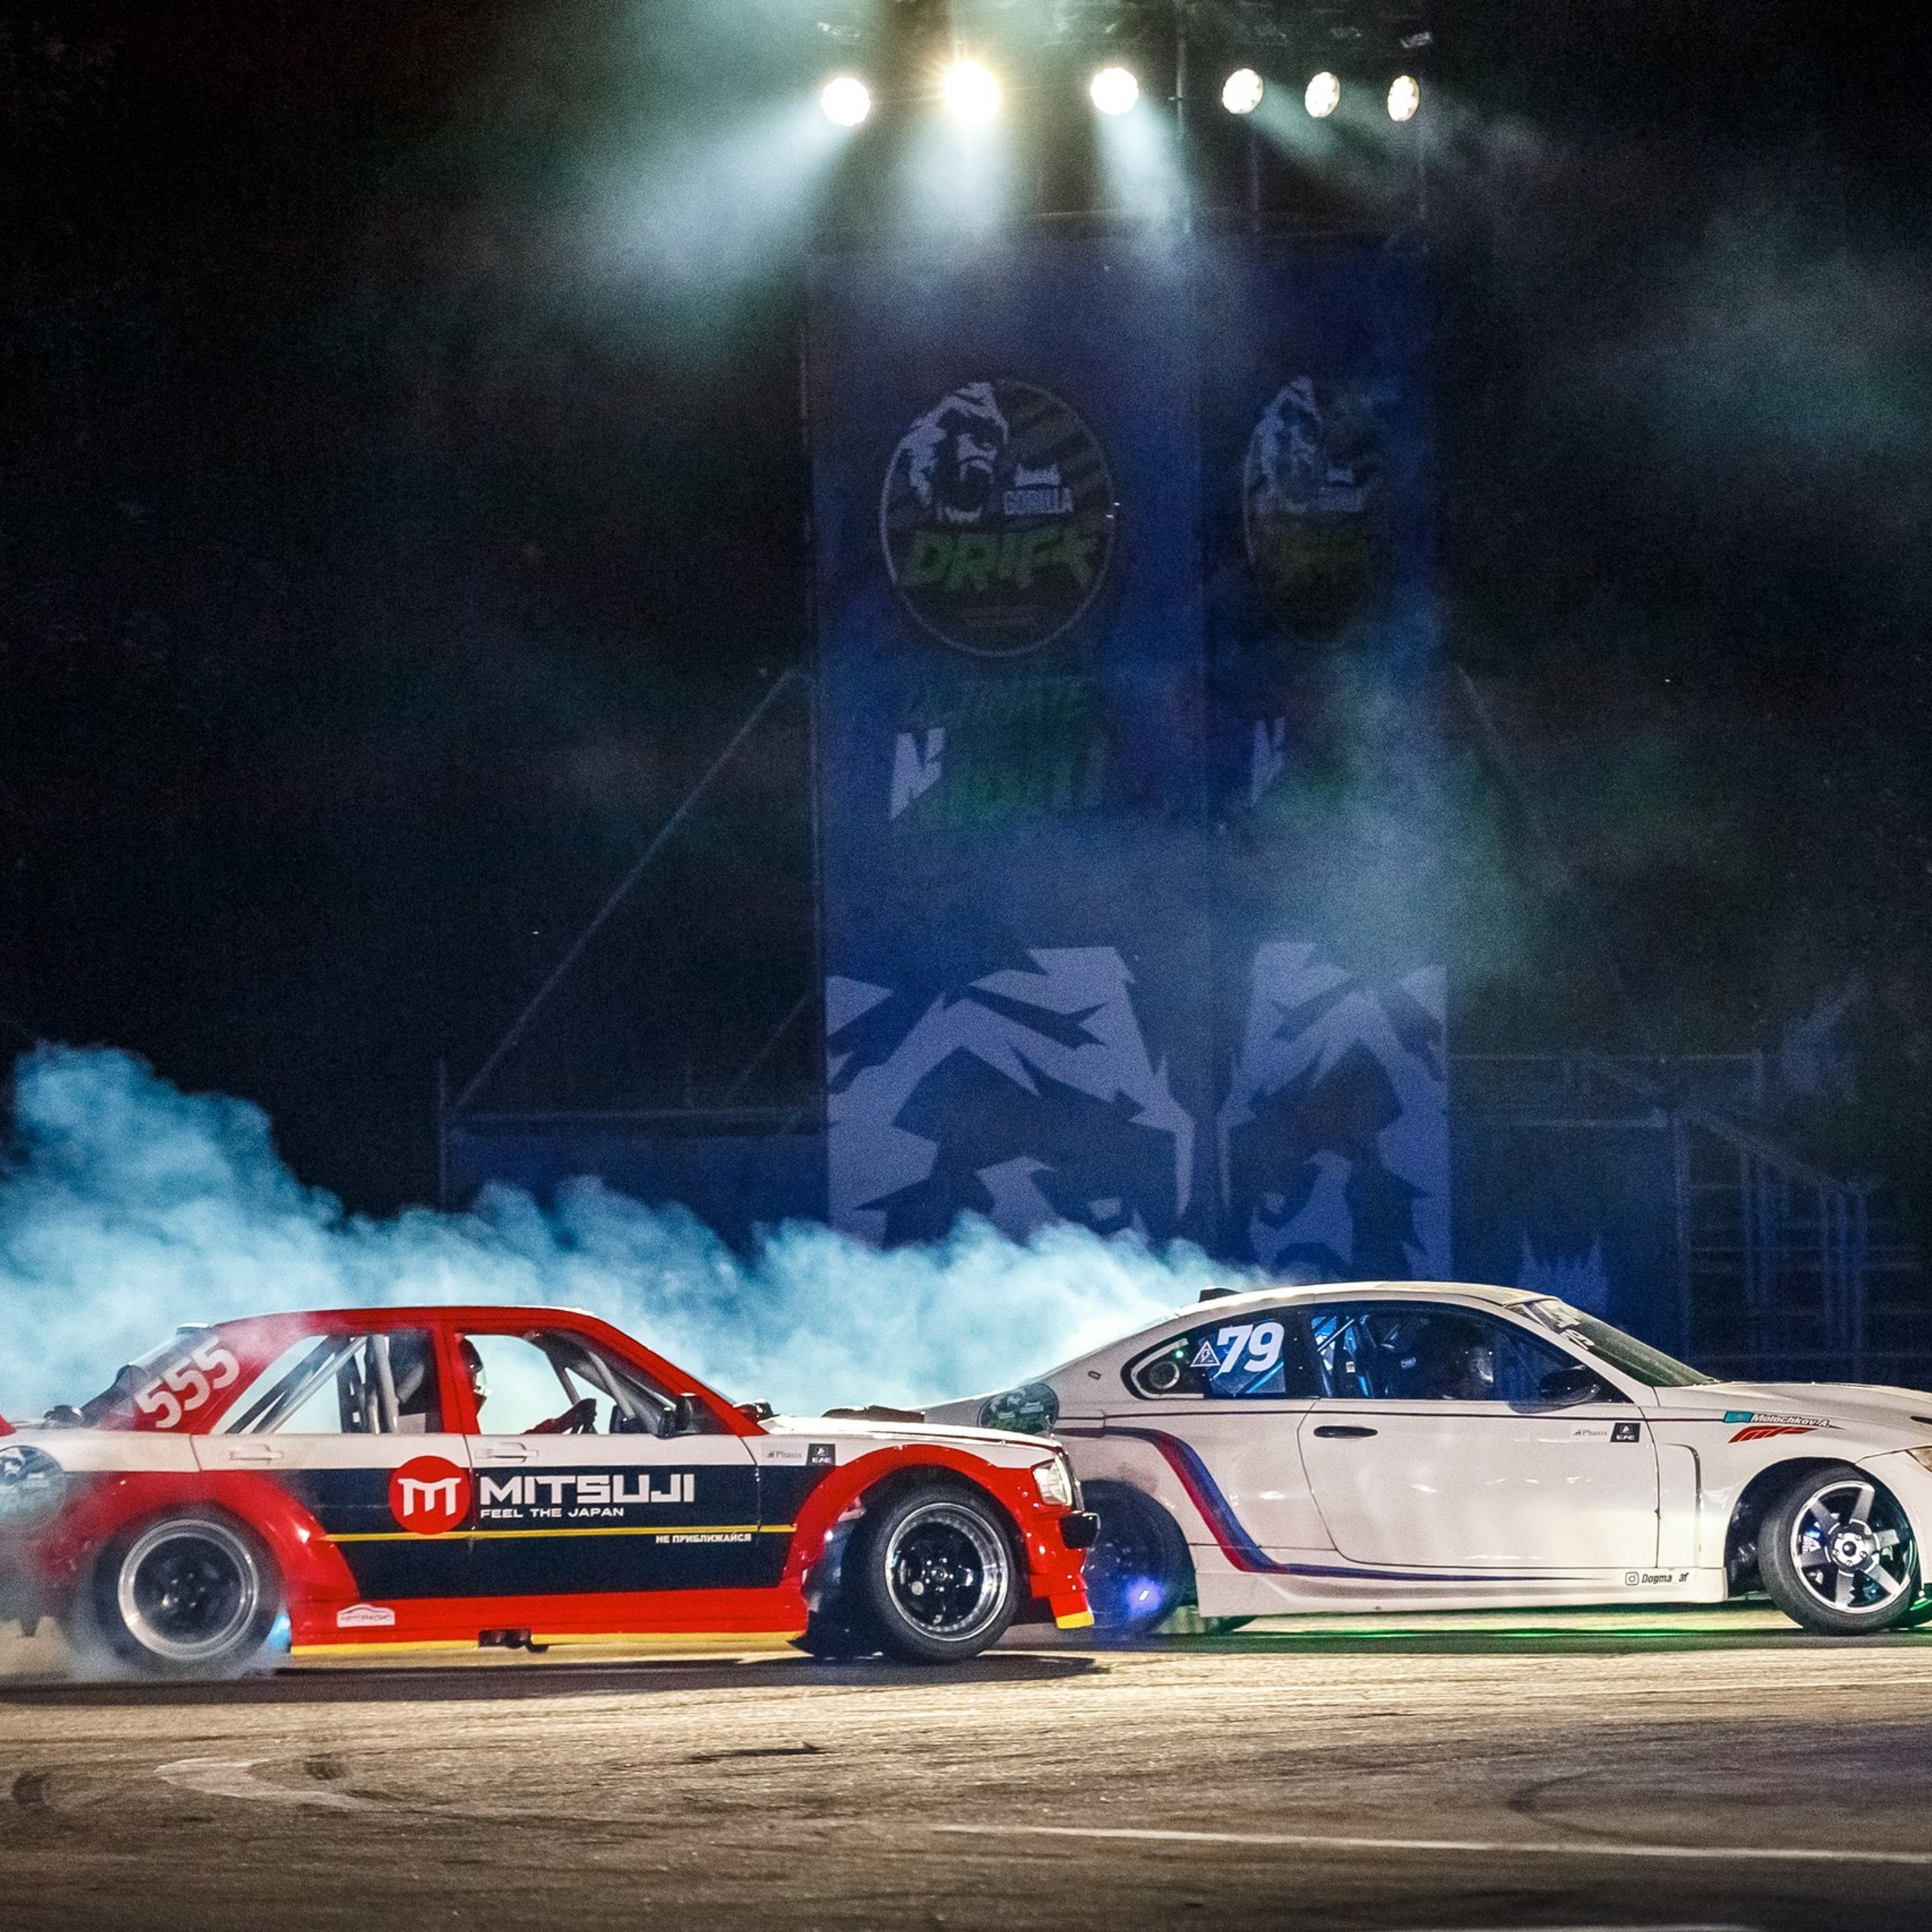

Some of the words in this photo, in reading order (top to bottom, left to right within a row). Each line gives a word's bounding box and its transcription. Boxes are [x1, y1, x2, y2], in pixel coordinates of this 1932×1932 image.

[1216, 1321, 1285, 1373] 79
[134, 1335, 240, 1429] 555
[480, 1474, 695, 1505] MITSUJI
[480, 1509, 524, 1519] FEEL
[530, 1508, 562, 1518] THE
[568, 1507, 624, 1518] JAPAN
[655, 1534, 670, 1544] НЕ
[672, 1531, 752, 1543] ПРИБЛИЖАЙСЯ
